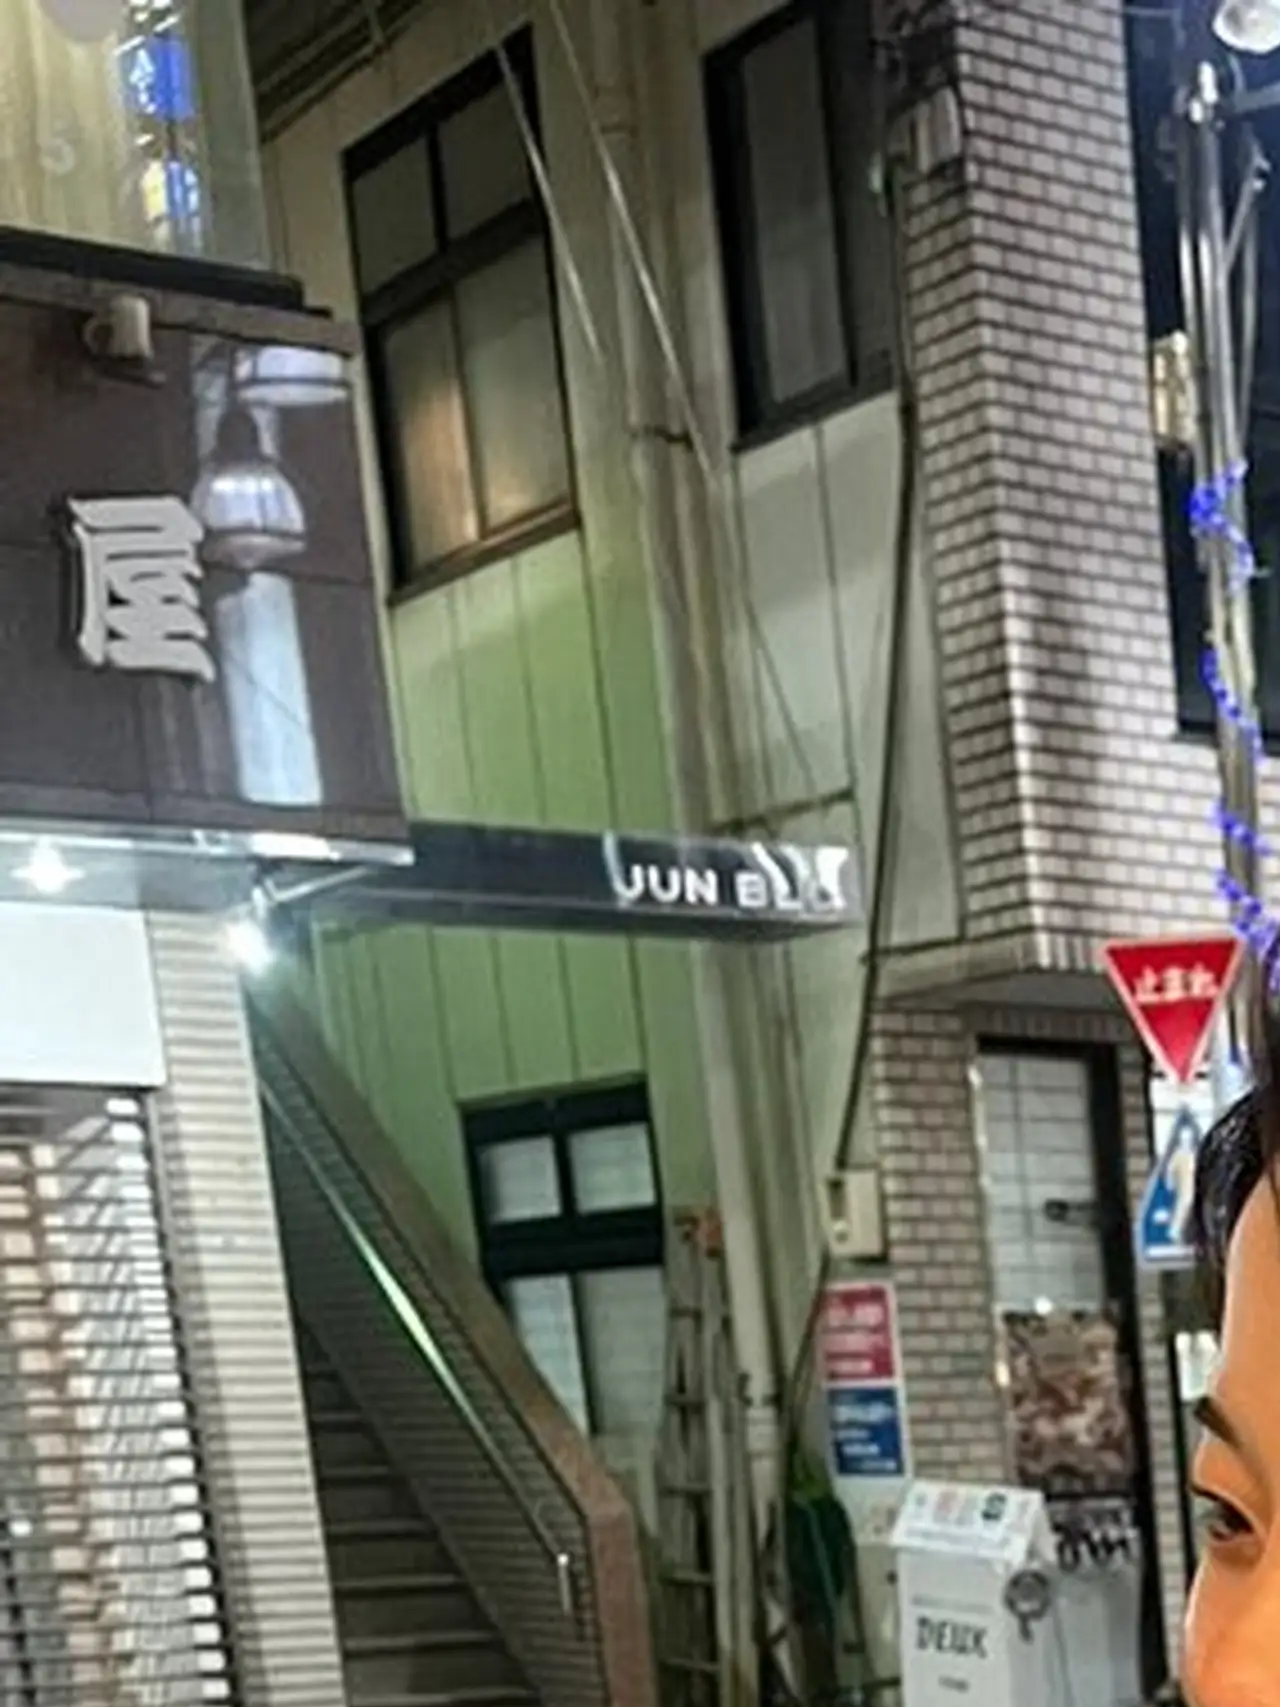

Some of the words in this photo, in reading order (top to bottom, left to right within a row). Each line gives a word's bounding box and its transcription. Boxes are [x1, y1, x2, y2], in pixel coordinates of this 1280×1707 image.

[66, 495, 214, 683] 屋
[1131, 960, 1221, 1004] 止まれ
